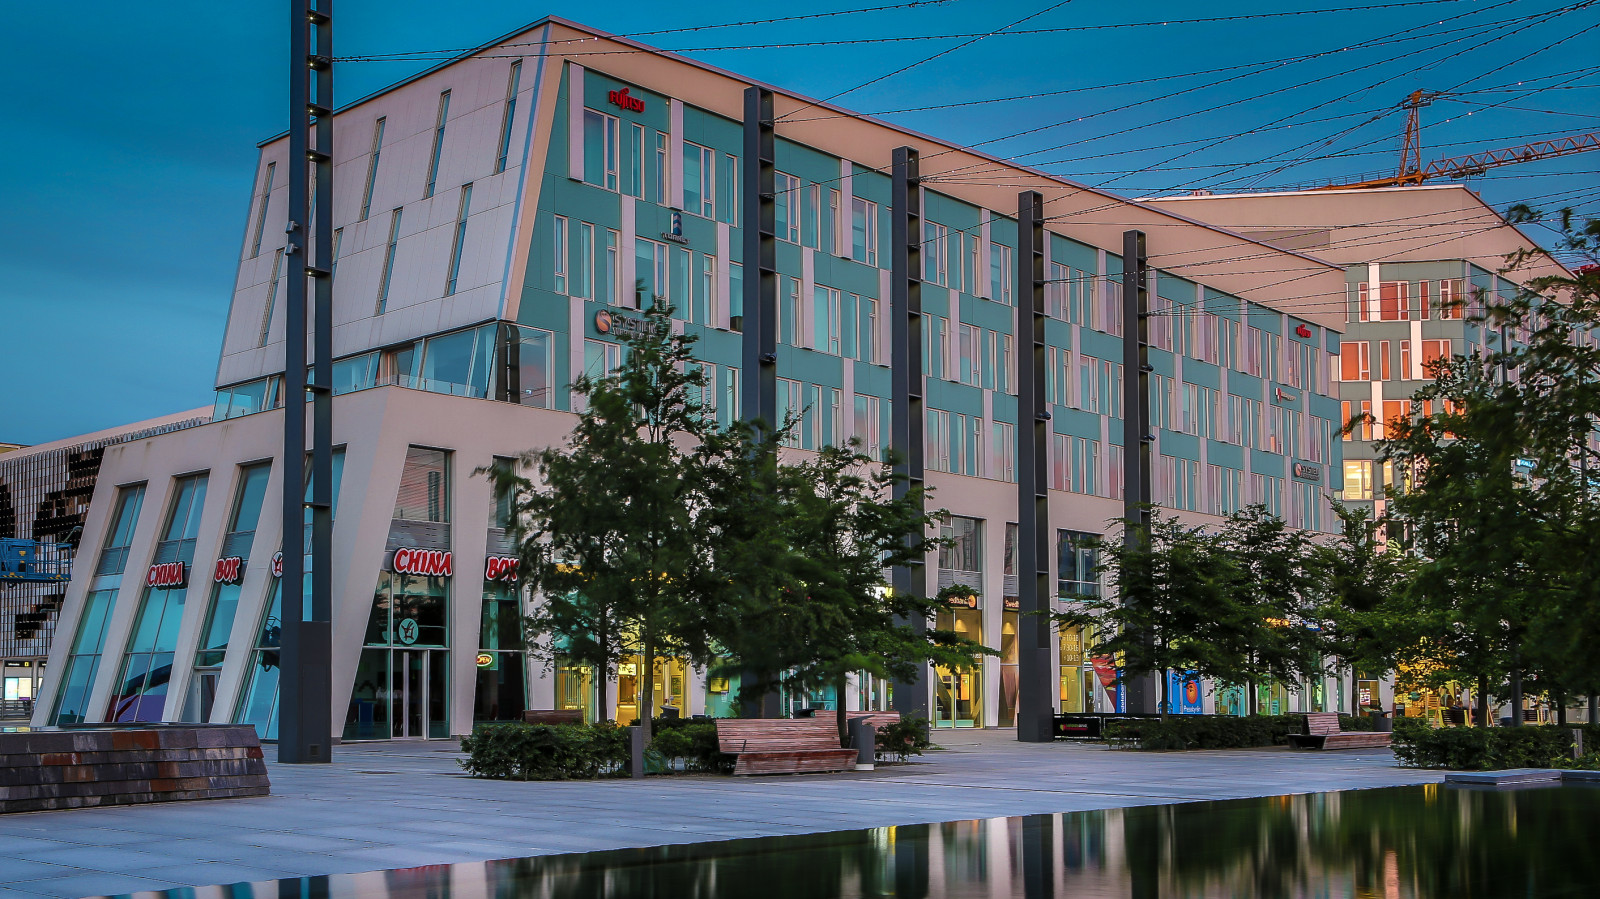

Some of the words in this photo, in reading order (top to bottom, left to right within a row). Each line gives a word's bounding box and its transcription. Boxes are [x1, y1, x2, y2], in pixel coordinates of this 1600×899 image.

[609, 86, 645, 112] FUJITSU
[147, 561, 184, 586] CHINA
[214, 556, 241, 583] BOX
[393, 547, 453, 576] CHINA
[485, 556, 519, 581] BOX
